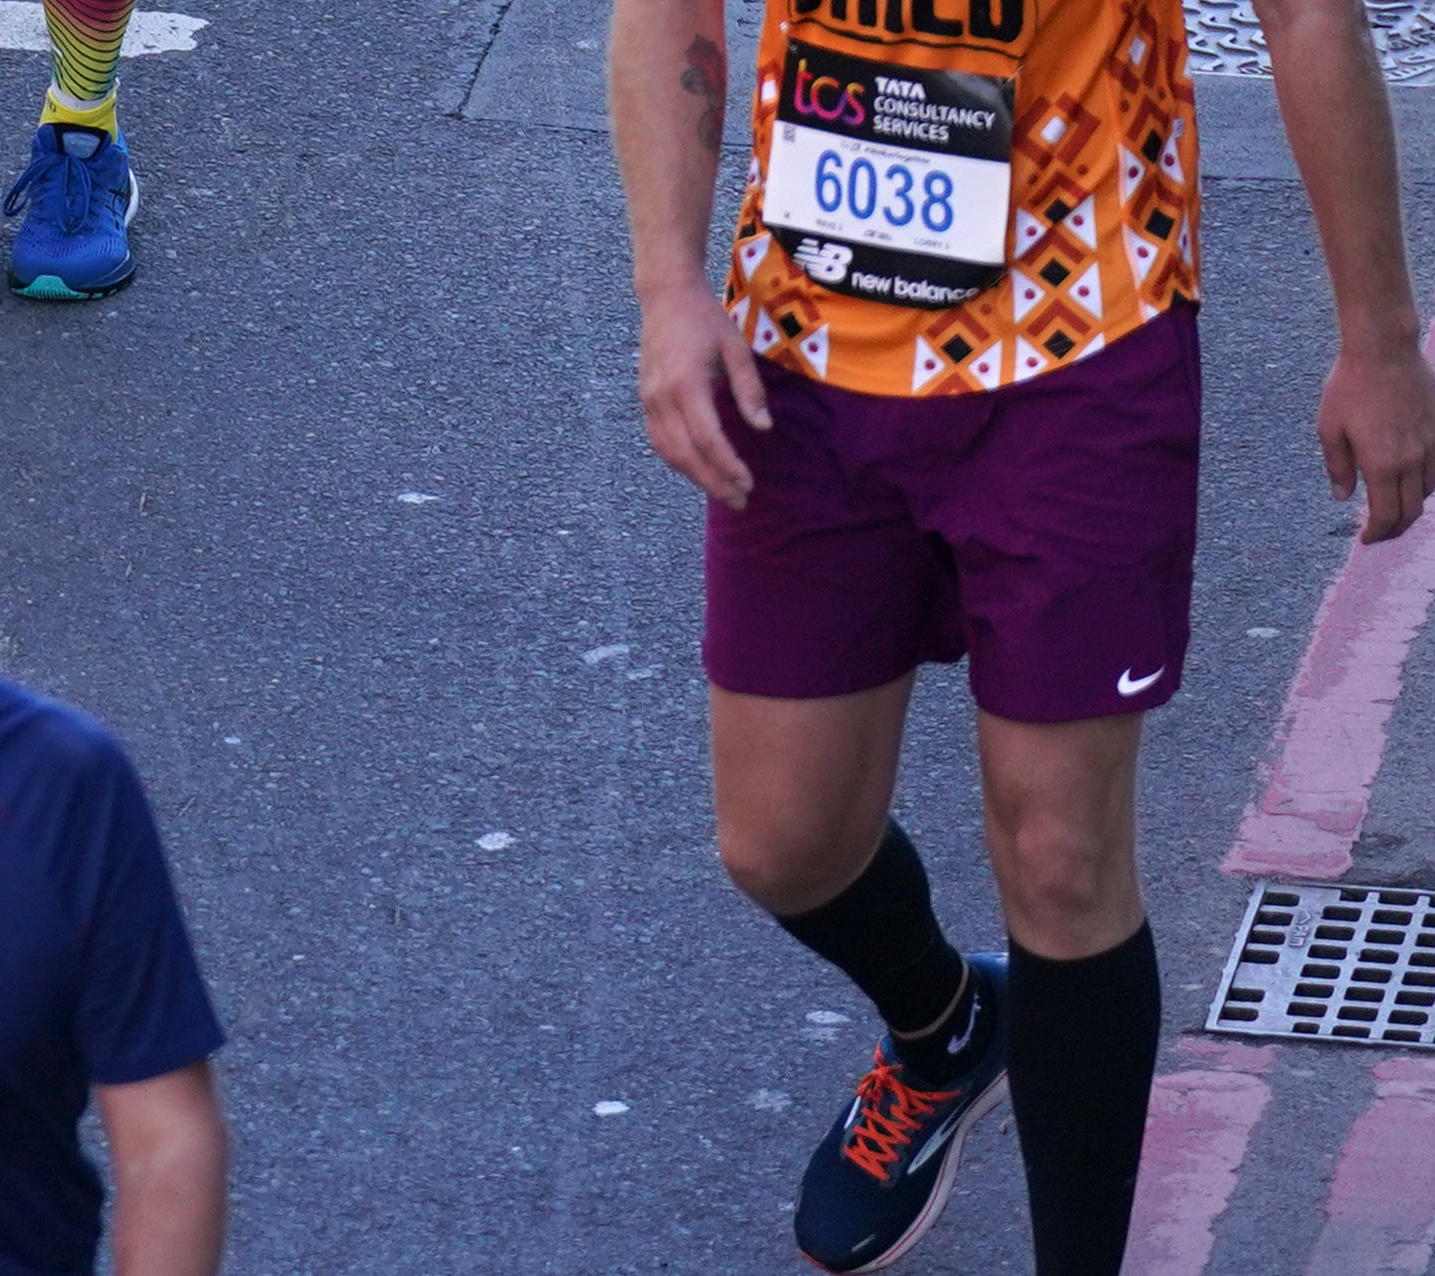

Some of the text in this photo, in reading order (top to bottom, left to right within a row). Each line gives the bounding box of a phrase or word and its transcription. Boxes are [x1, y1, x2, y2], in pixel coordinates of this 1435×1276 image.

[794, 58, 867, 127] tcs
[875, 75, 926, 100] TATA
[873, 96, 996, 131] CONSULTANCY
[873, 115, 950, 143] SERVICES
[815, 149, 954, 233] 6038
[851, 271, 891, 292] new
[893, 275, 980, 302] balance
